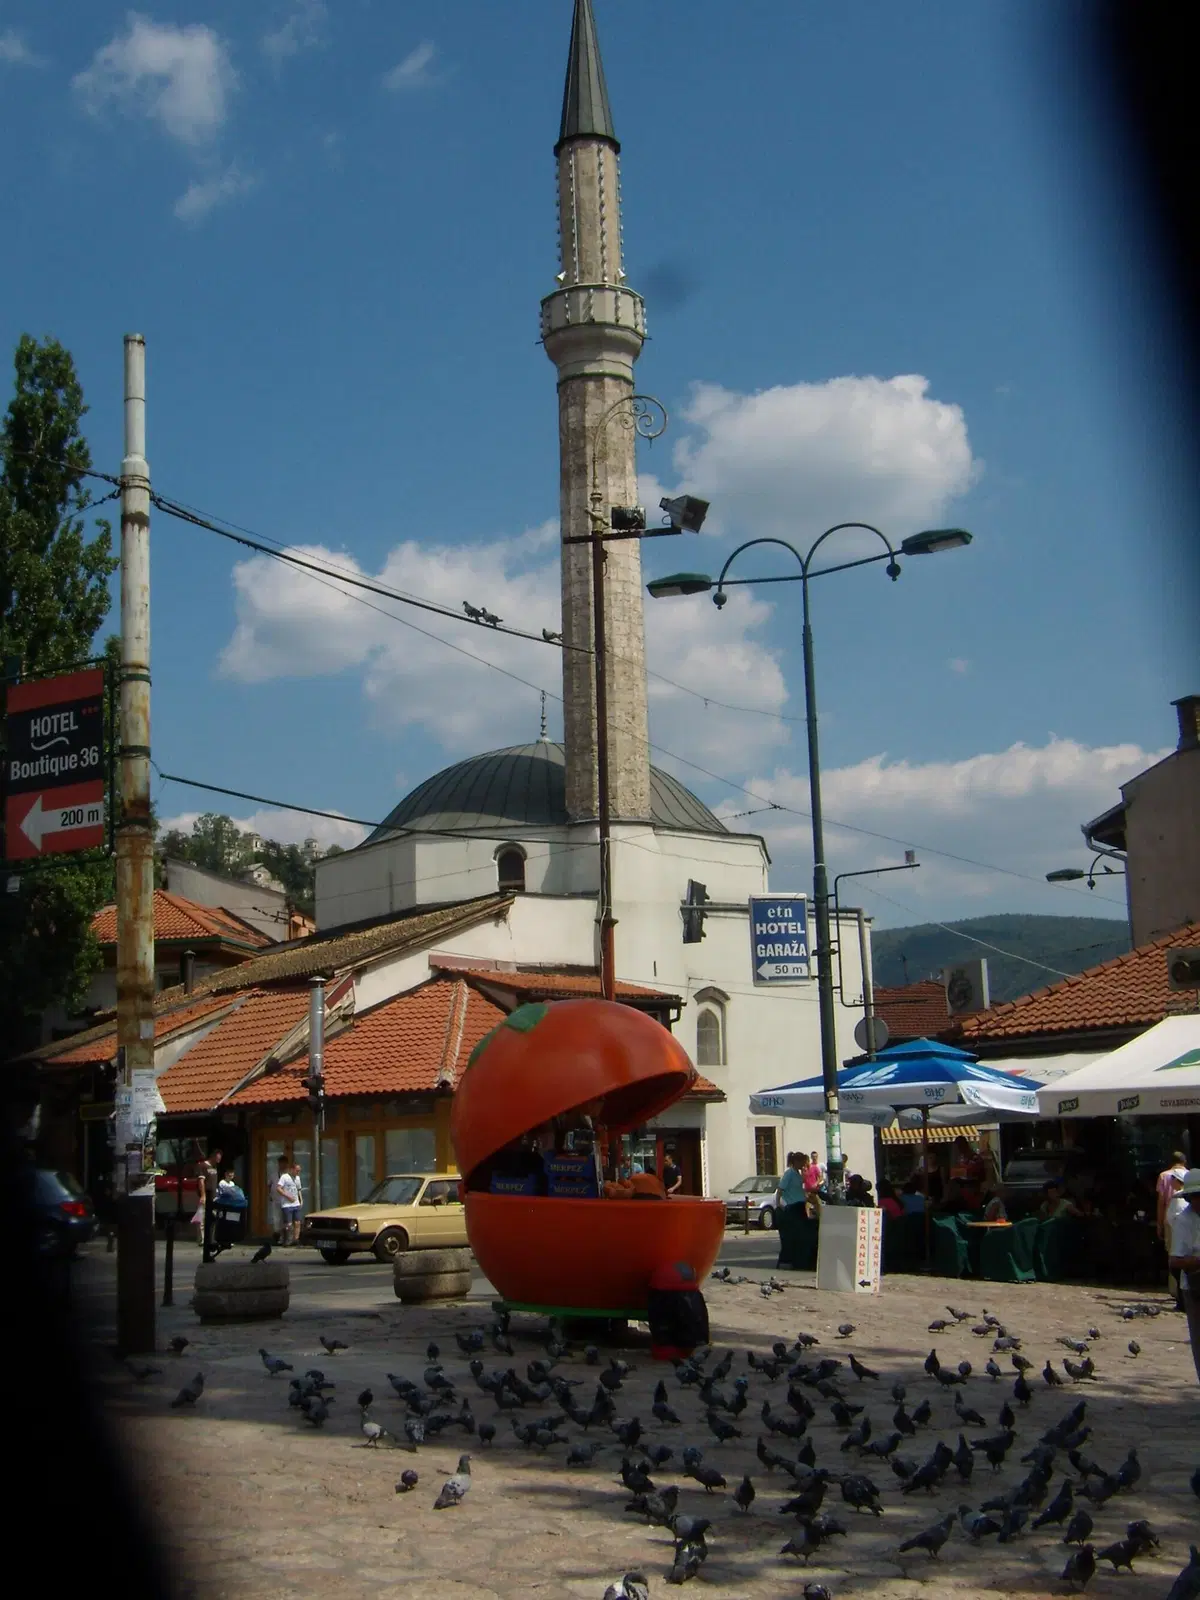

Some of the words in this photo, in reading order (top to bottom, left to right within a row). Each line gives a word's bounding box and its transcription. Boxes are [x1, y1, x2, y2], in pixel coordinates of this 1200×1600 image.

[30, 711, 78, 738] HOTEL
[10, 753, 78, 781] Boutique
[80, 746, 99, 767] 36
[61, 809, 84, 827] 200
[87, 809, 99, 823] m
[768, 906, 792, 918] etn
[756, 923, 806, 935] HOTEL
[757, 940, 807, 957] GARAŽA
[775, 965, 789, 974] 50
[792, 966, 803, 974] m
[859, 1210, 867, 1275] EXCHANGE
